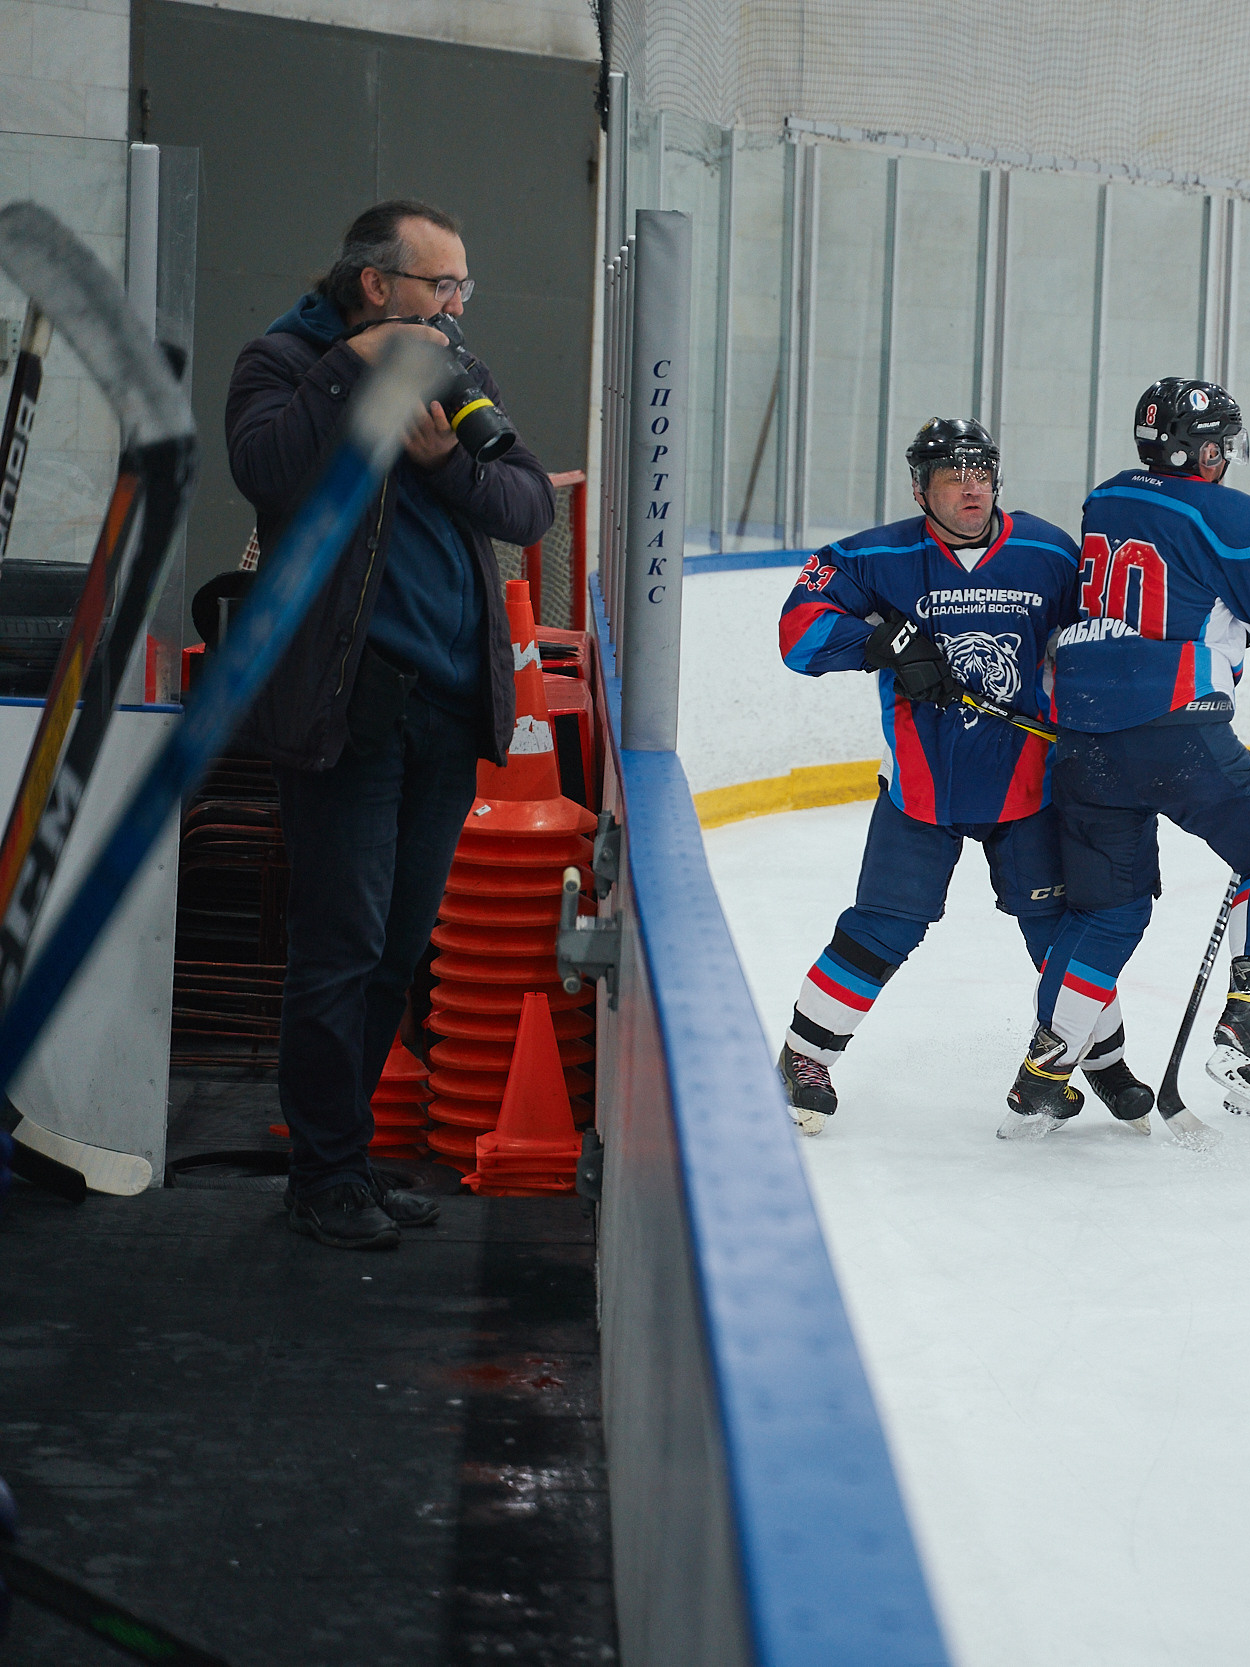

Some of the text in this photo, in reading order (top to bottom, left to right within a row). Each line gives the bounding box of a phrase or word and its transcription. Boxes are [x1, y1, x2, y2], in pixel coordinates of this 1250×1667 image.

[1146, 403, 1158, 425] 8
[645, 359, 672, 604] СПОРТМАКС
[1131, 475, 1164, 487] MAVEX
[795, 554, 838, 592] 23
[1078, 532, 1168, 640] 30
[928, 588, 1043, 607] ТРАНСНЕФТЬ
[931, 601, 1029, 616] ДАЛЬНИЙ ВОСТОК
